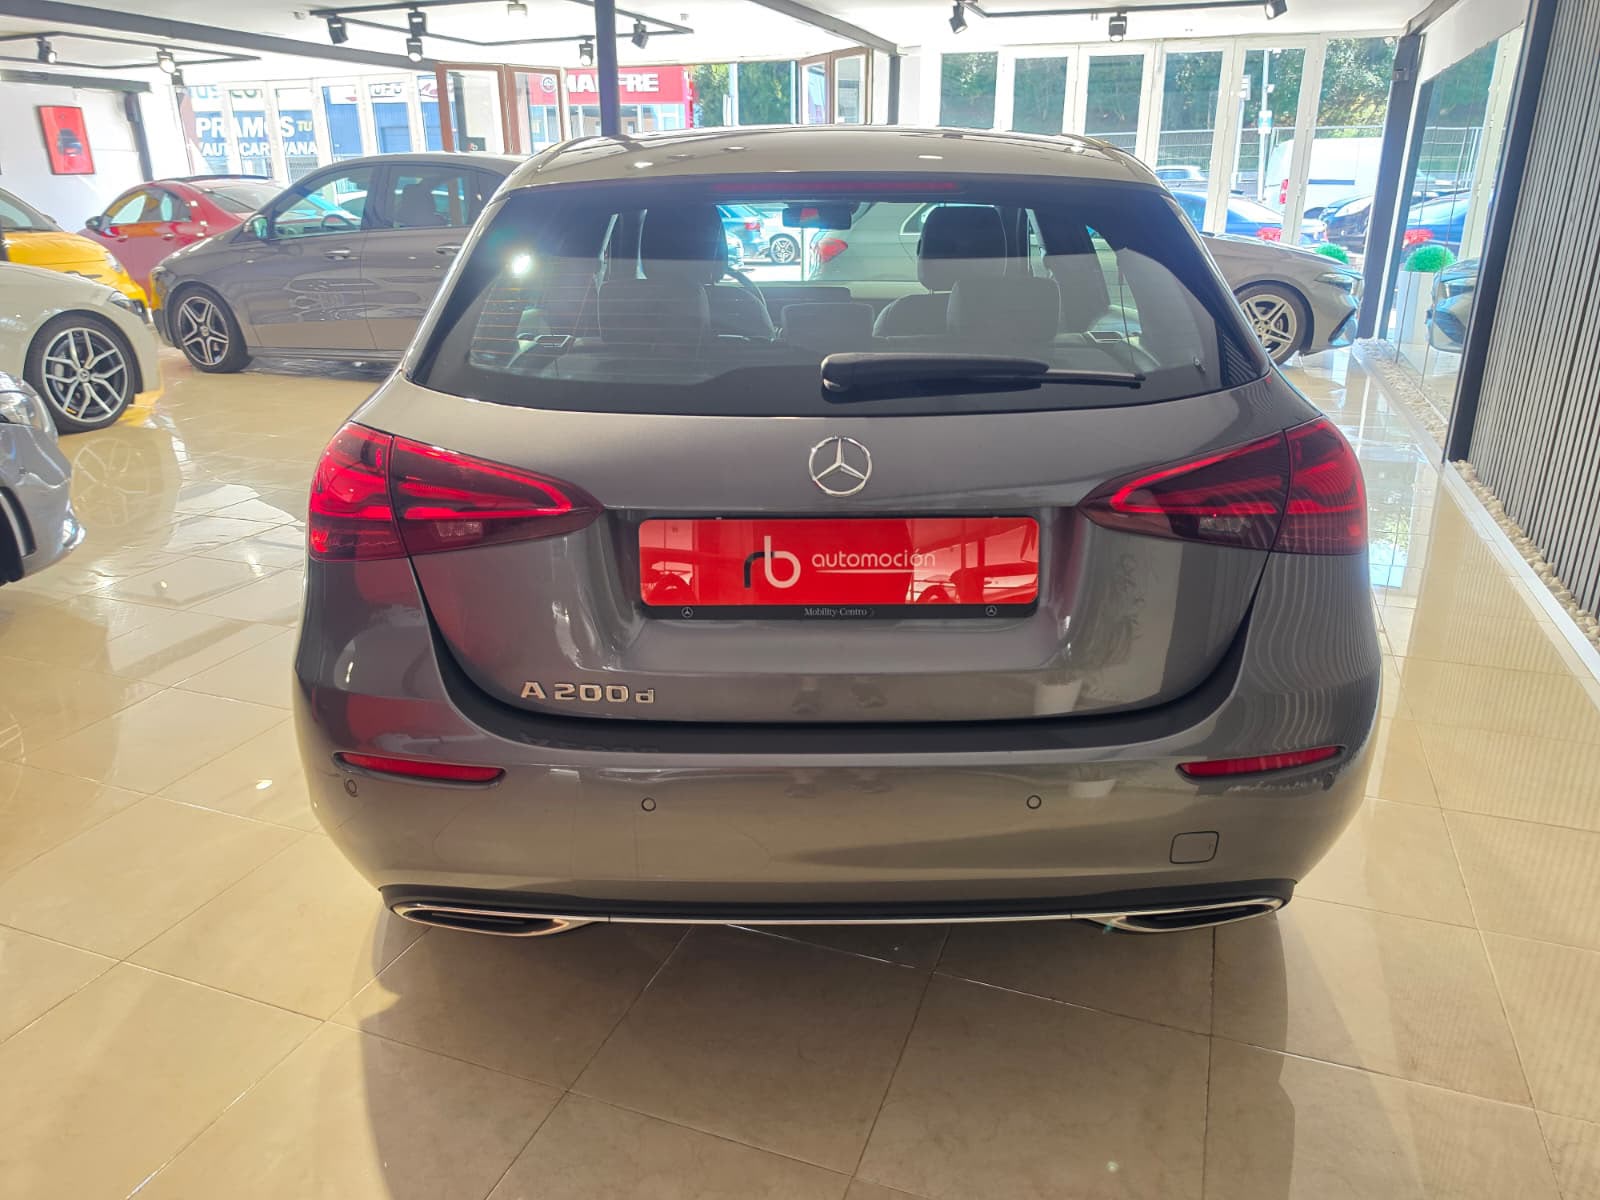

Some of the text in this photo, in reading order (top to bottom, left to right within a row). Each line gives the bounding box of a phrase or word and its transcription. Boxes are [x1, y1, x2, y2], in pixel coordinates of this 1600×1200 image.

[567, 74, 659, 92] MAFRE
[195, 116, 312, 138] PRAMS TU
[812, 549, 936, 567] automoción
[804, 608, 867, 617] Mobility Centro
[520, 681, 655, 703] A 200 d
